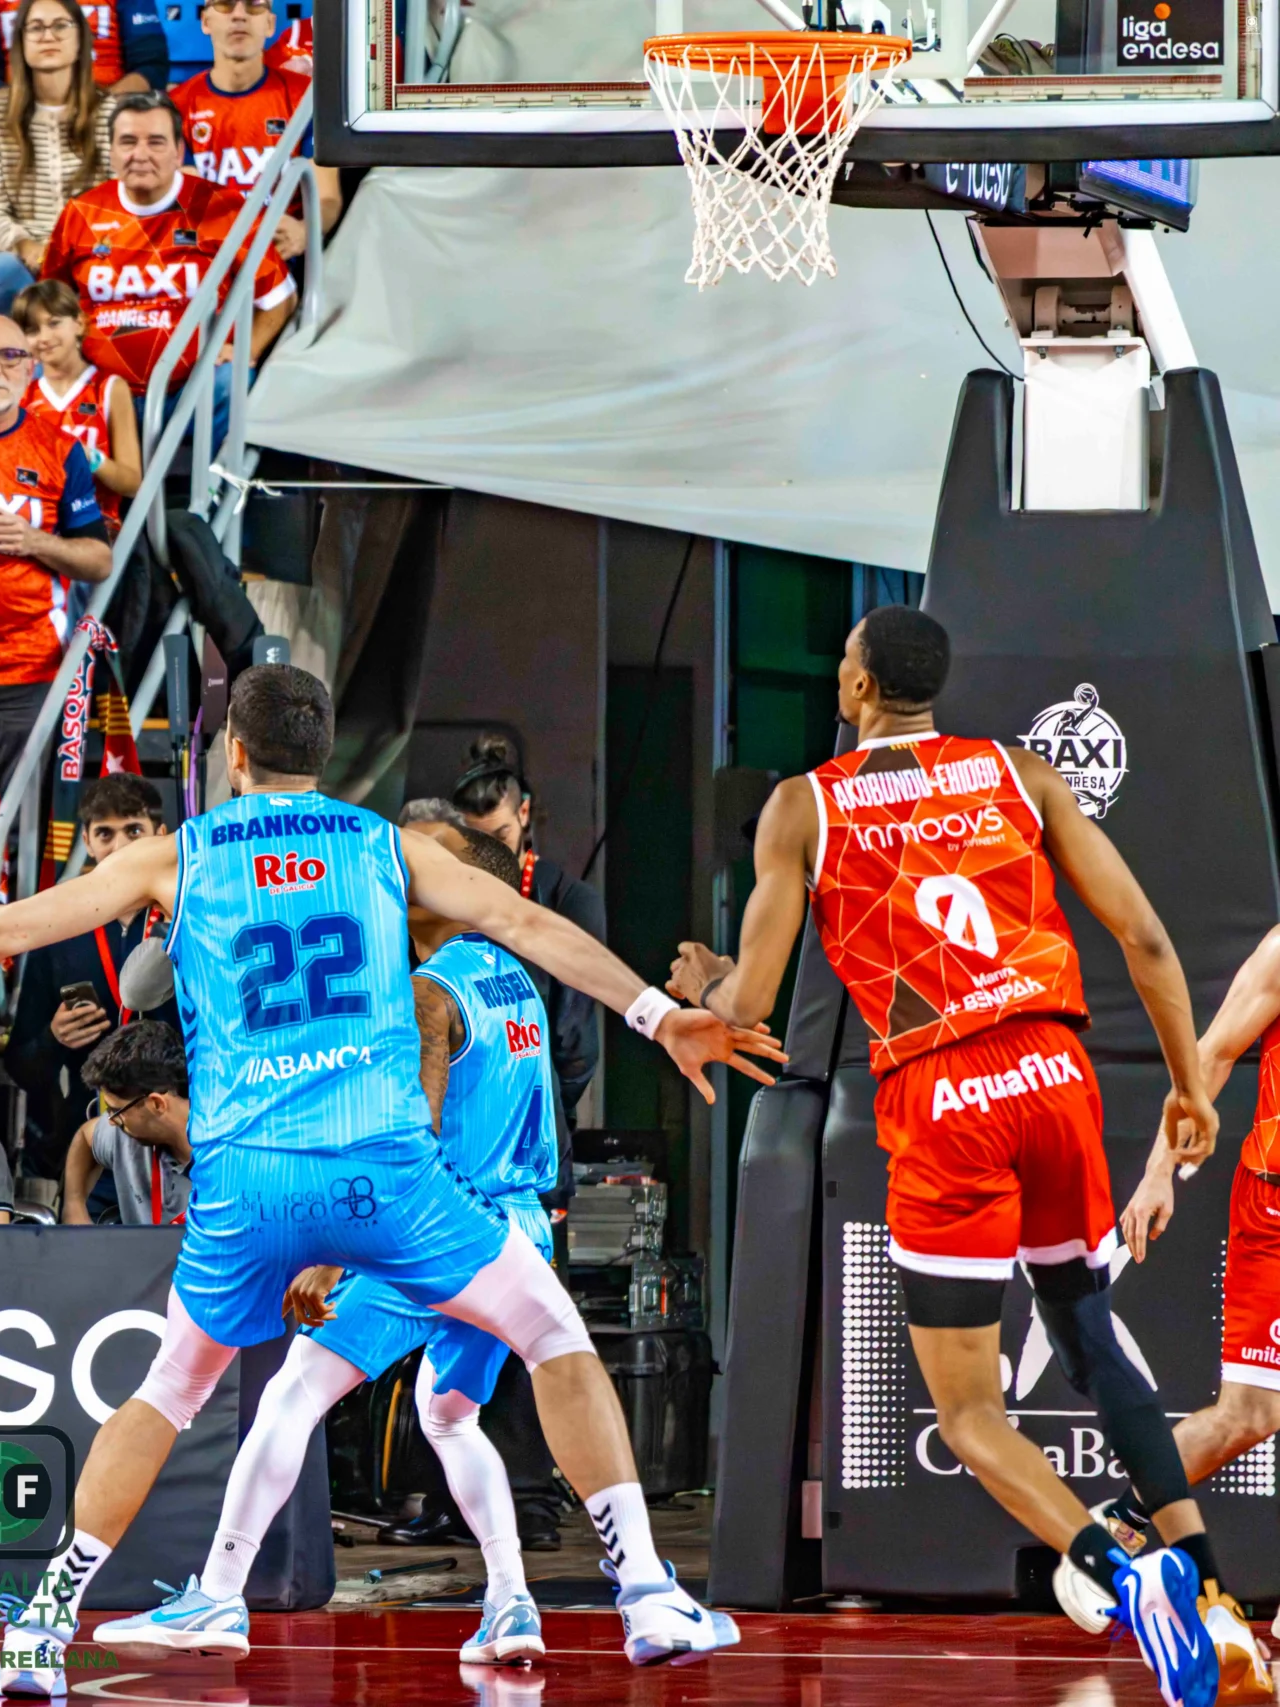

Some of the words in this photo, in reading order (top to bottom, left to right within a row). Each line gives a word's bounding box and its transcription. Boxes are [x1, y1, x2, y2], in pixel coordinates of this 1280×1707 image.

[1122, 16, 1166, 40] liga
[1122, 38, 1219, 59] endesa
[194, 146, 275, 186] BAX
[88, 262, 200, 301] BAXI
[58, 659, 85, 781] BÀSQU
[1028, 739, 1122, 768] BAXI
[832, 756, 1001, 812] AKOBUNDU-EHIOGU
[1065, 776, 1106, 790] NRESA
[211, 814, 362, 847] BRANKOVIC
[854, 806, 1004, 852] inmoovs
[254, 852, 326, 888] Río
[231, 912, 370, 1036] 22
[932, 1051, 1083, 1122] Aquaflix
